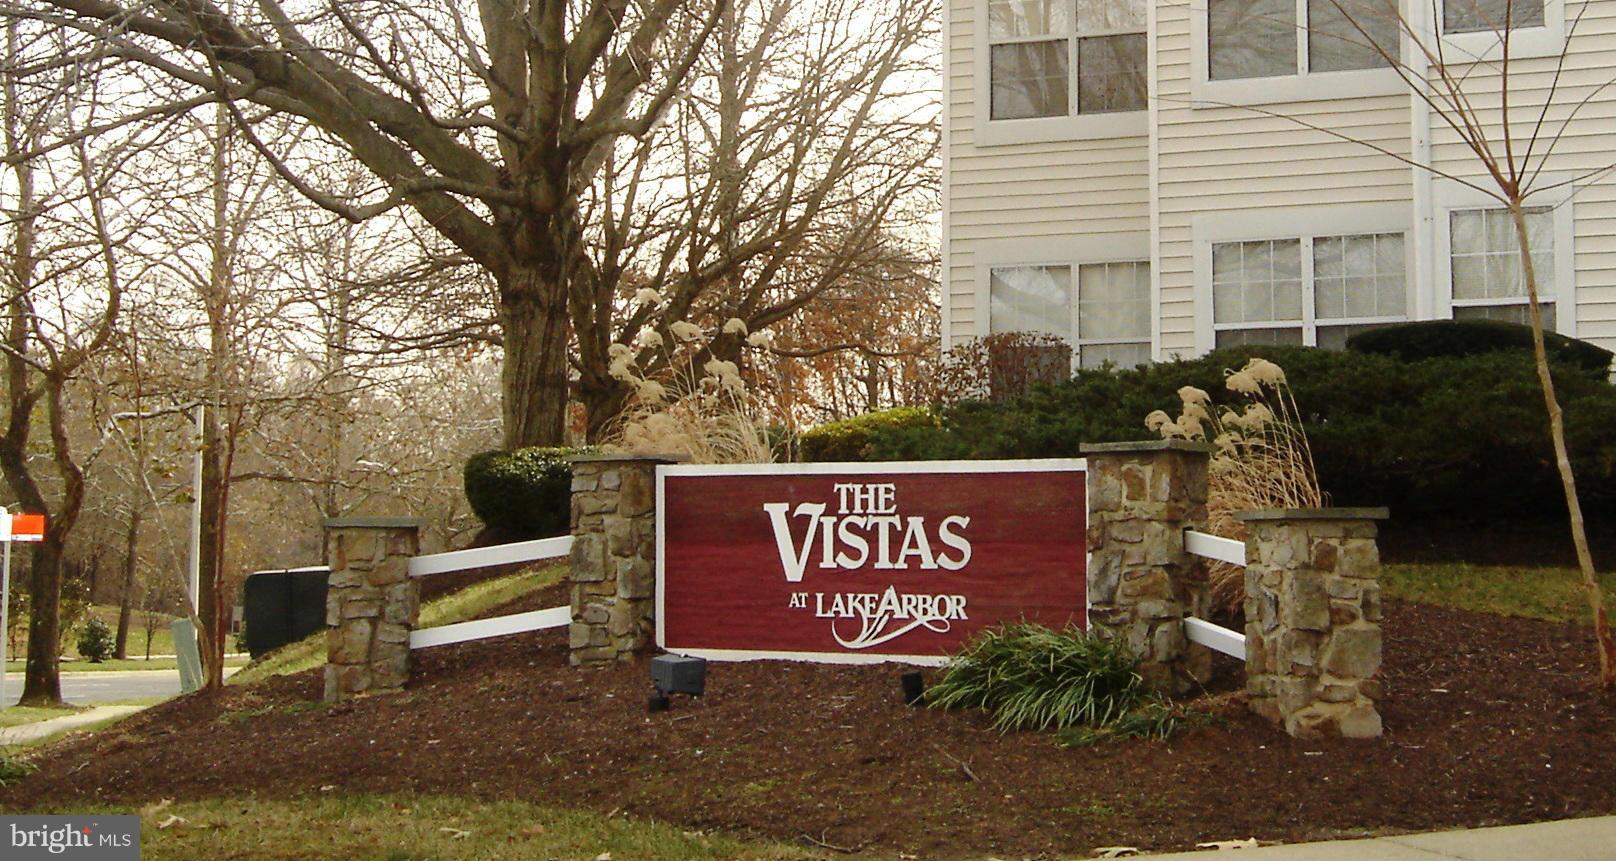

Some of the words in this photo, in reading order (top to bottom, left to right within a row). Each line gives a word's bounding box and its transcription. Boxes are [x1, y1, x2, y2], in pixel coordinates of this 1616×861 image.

[833, 482, 897, 514] THE
[763, 502, 972, 582] VISTAS
[788, 592, 809, 608] AT
[815, 592, 880, 618] LAKE
[878, 584, 969, 620] ARBOR
